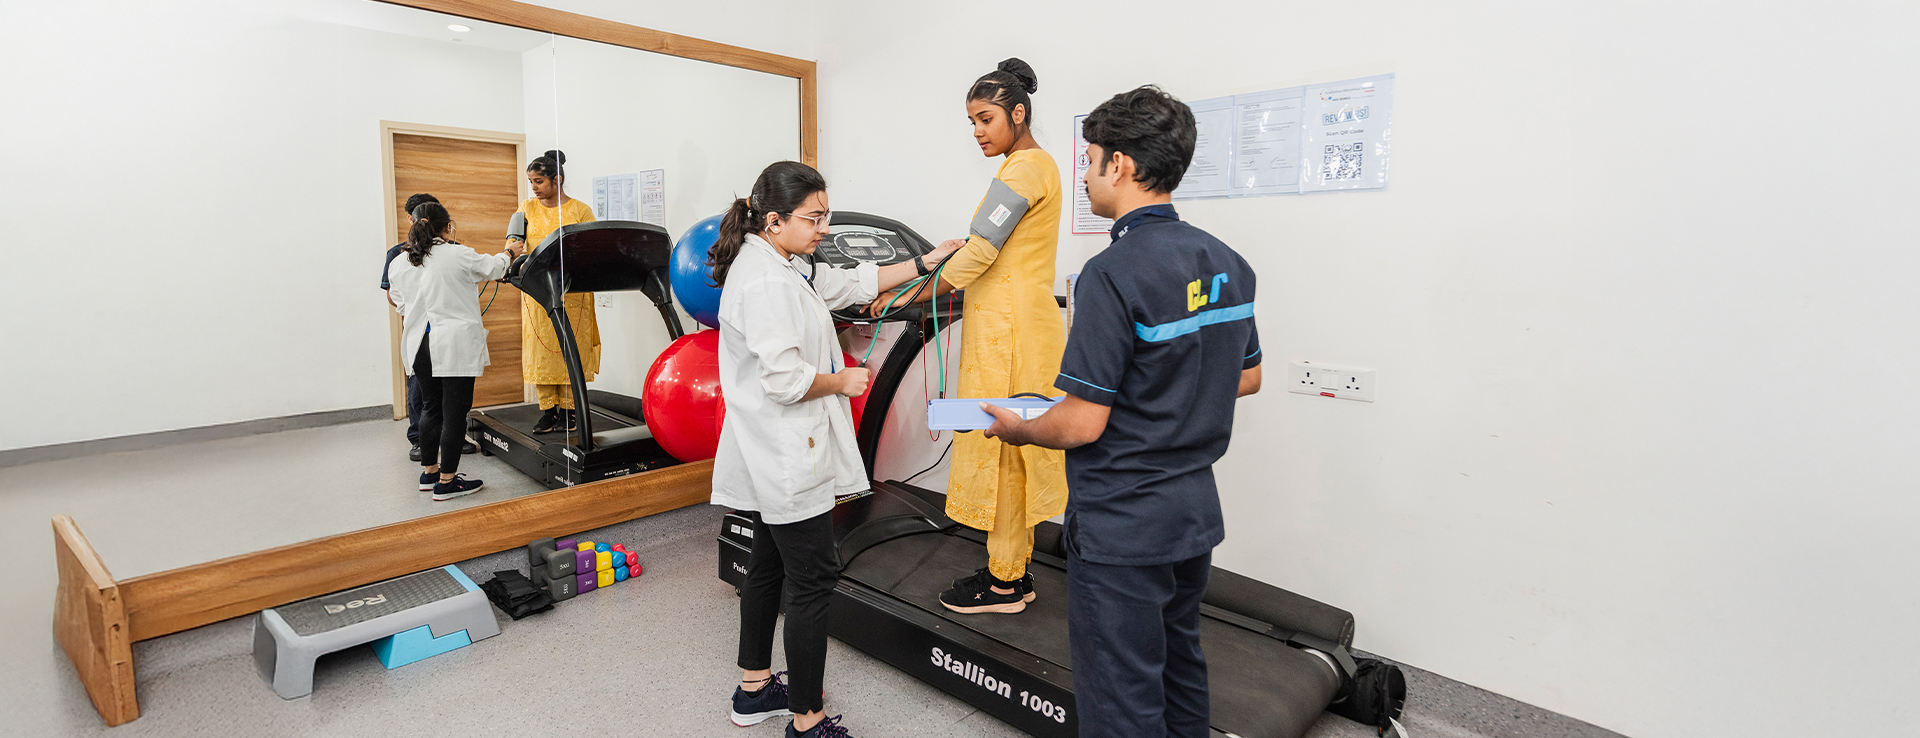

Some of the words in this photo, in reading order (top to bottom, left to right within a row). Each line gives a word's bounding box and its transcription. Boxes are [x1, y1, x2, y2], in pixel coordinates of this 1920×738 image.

[1325, 110, 1353, 124] REVW
[930, 646, 1012, 699] Stallion
[1020, 690, 1067, 724] 1003
